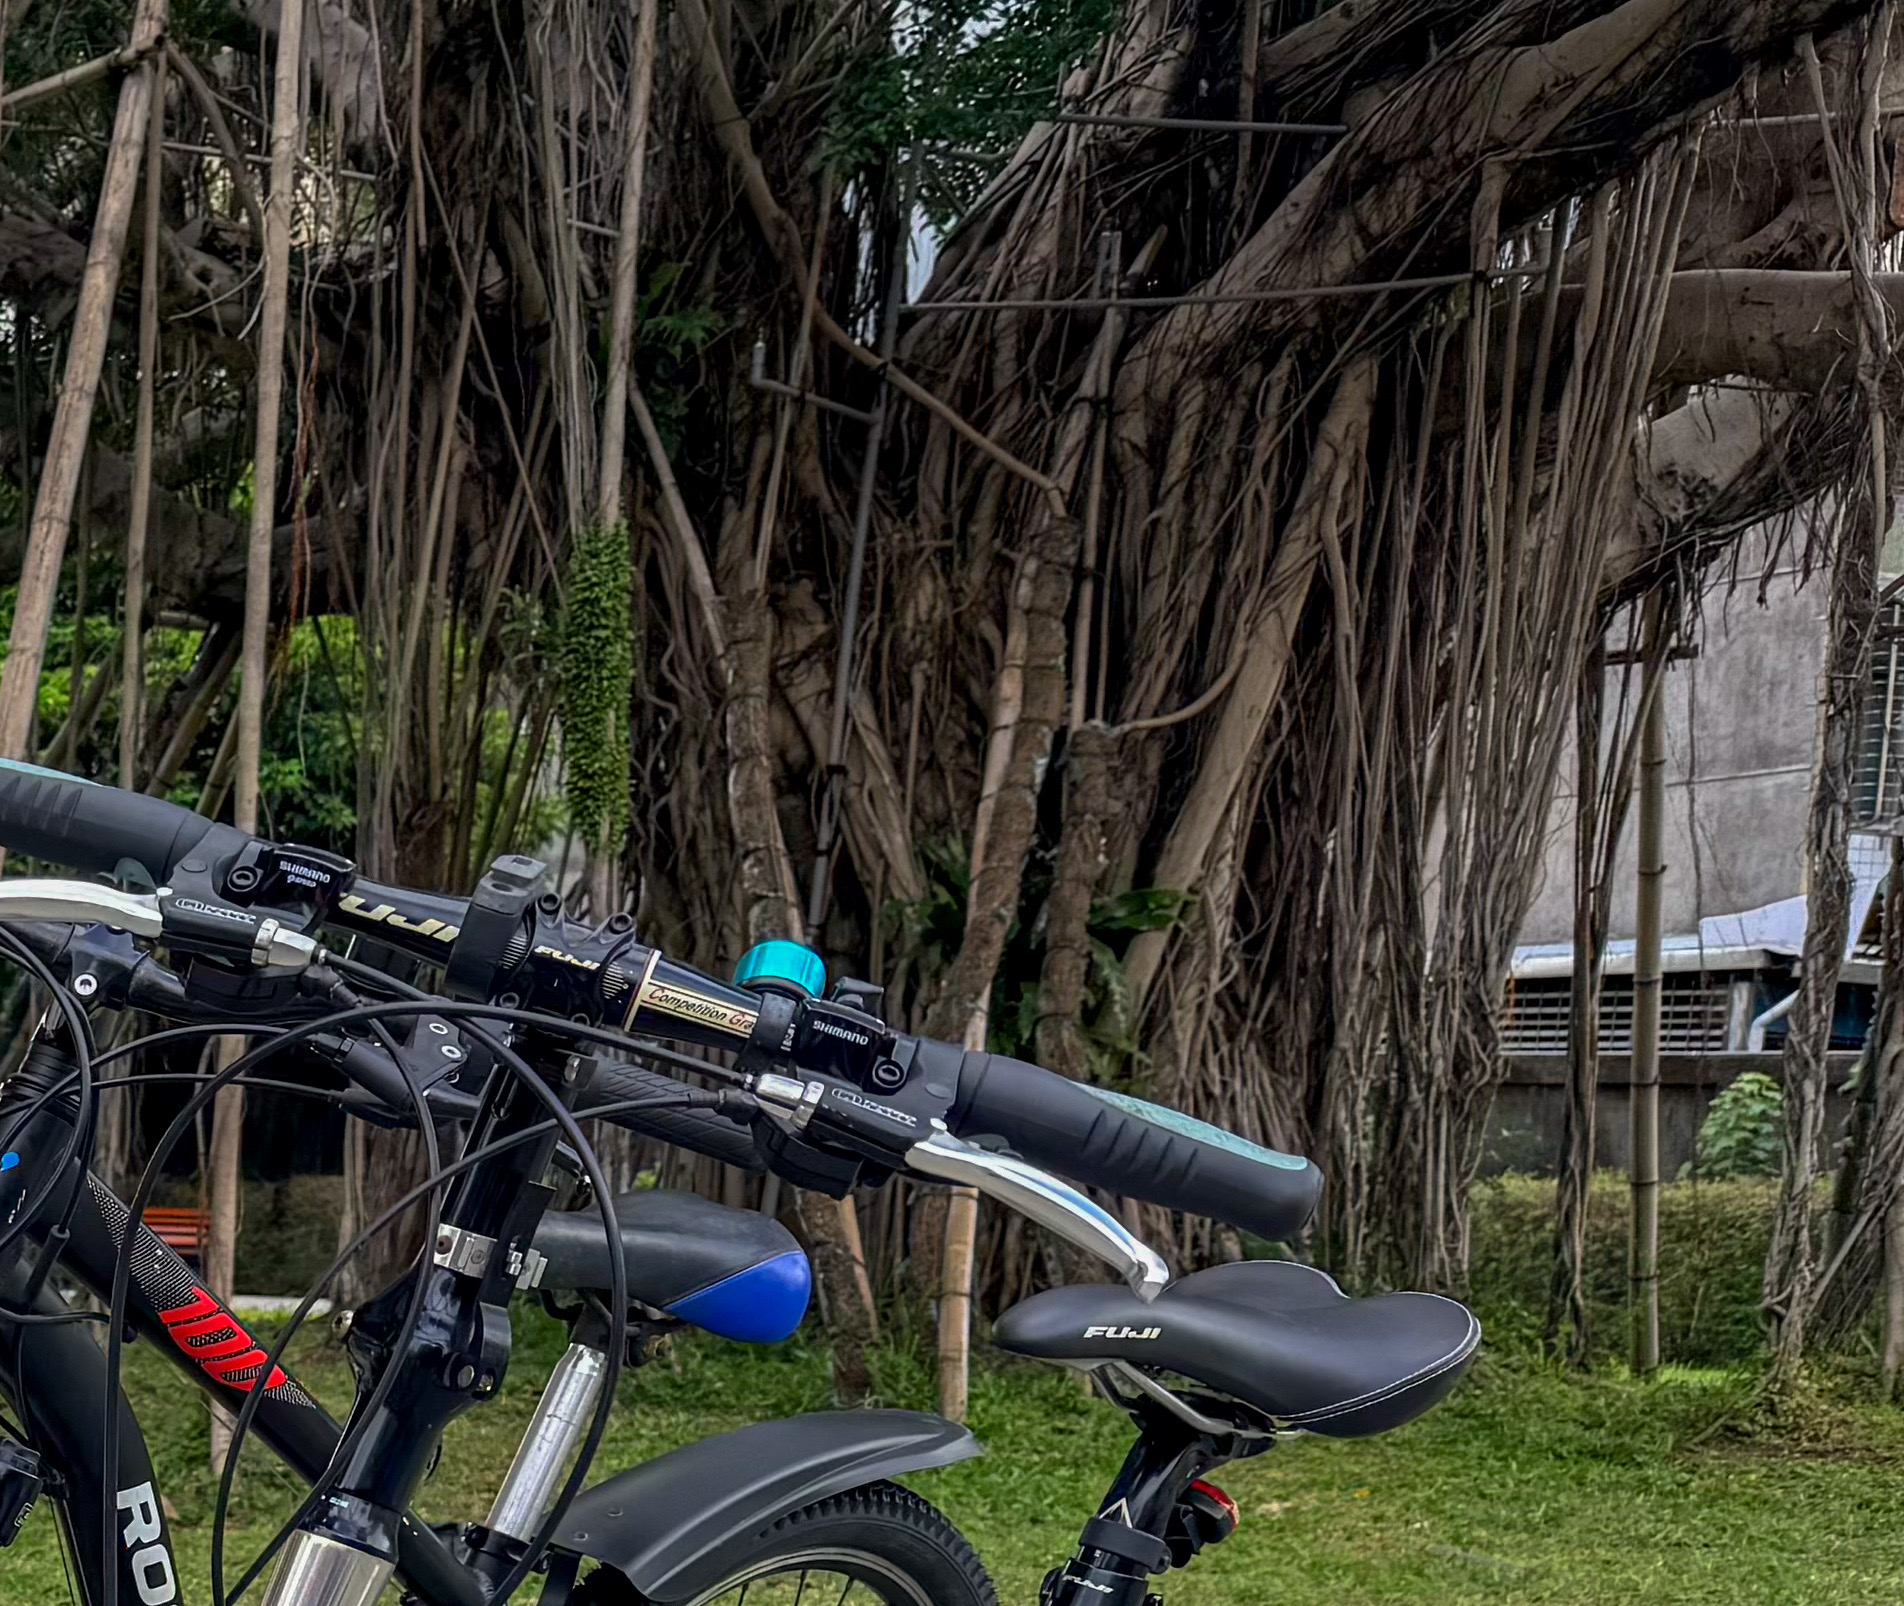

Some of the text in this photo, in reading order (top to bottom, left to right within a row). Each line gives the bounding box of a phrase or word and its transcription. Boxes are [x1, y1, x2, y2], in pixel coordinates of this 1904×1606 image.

[280, 861, 331, 884] SHIMANO
[339, 894, 460, 942] UJI
[534, 946, 600, 970] FUJI
[648, 987, 758, 1031] Competition Gra
[813, 1020, 869, 1046] SHIMANO
[1083, 1326, 1161, 1339] FUJI
